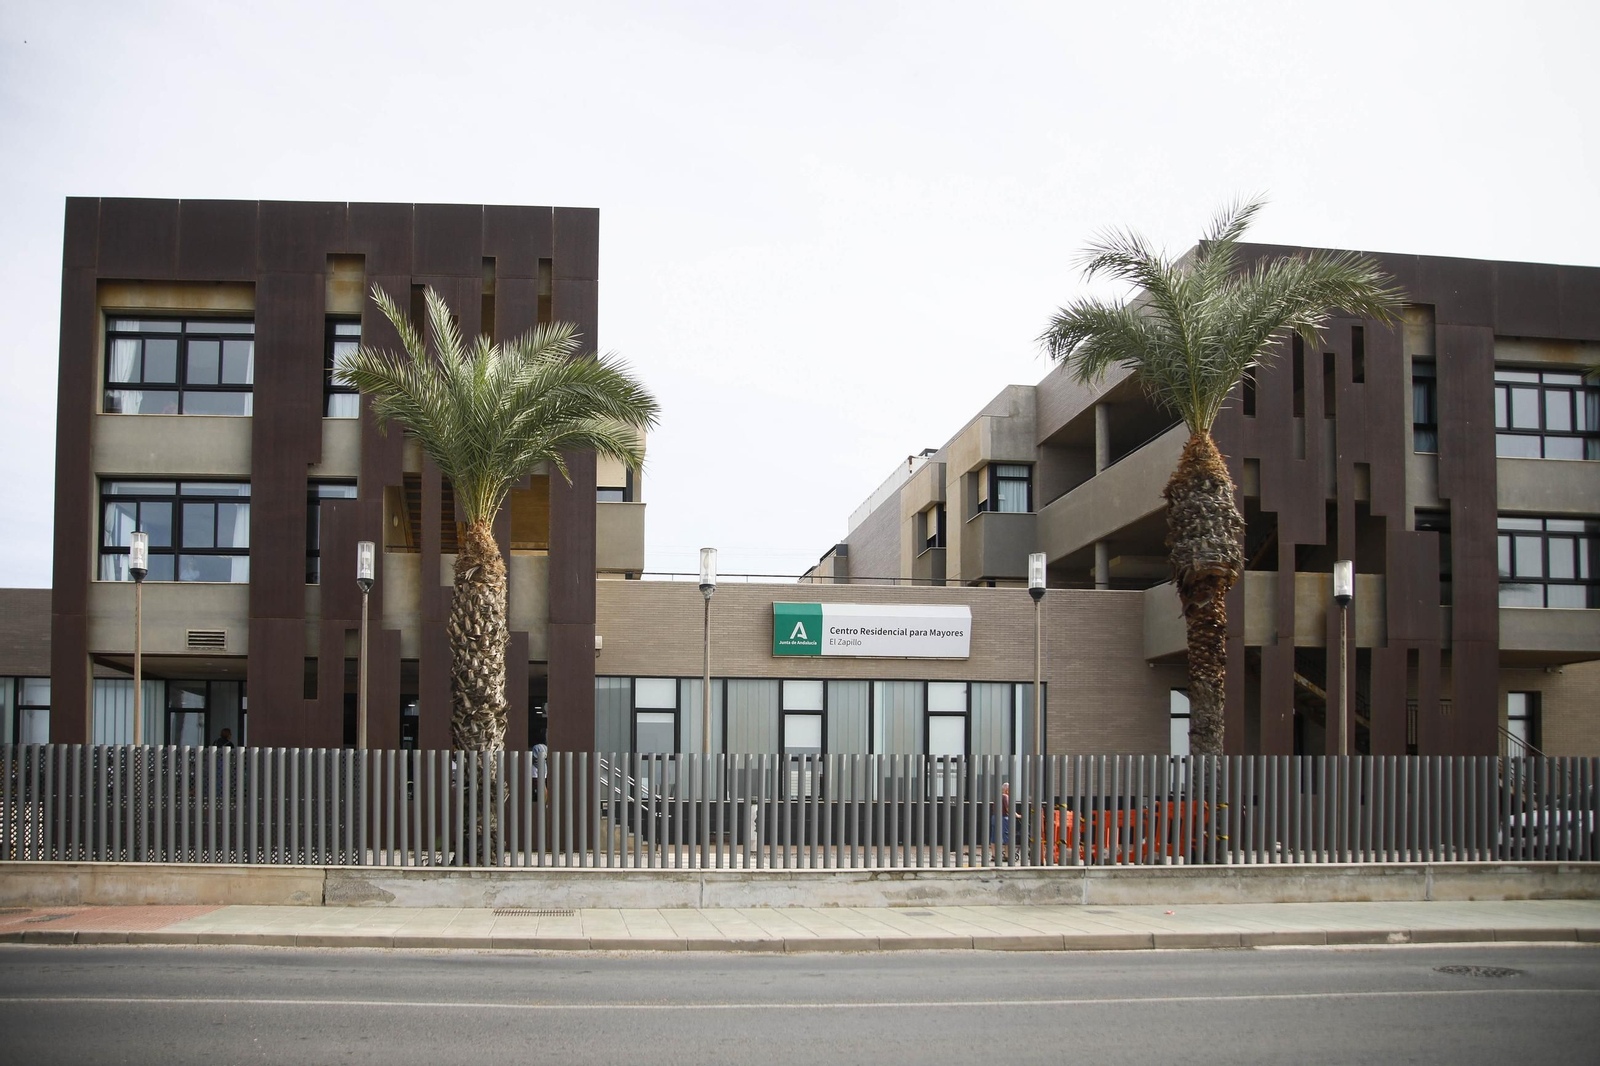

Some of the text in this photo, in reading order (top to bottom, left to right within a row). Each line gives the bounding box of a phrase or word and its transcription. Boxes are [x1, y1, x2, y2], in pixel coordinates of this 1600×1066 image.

[829, 626, 964, 638] Centro Residencial para Mayores
[829, 638, 862, 647] El Zapillo
